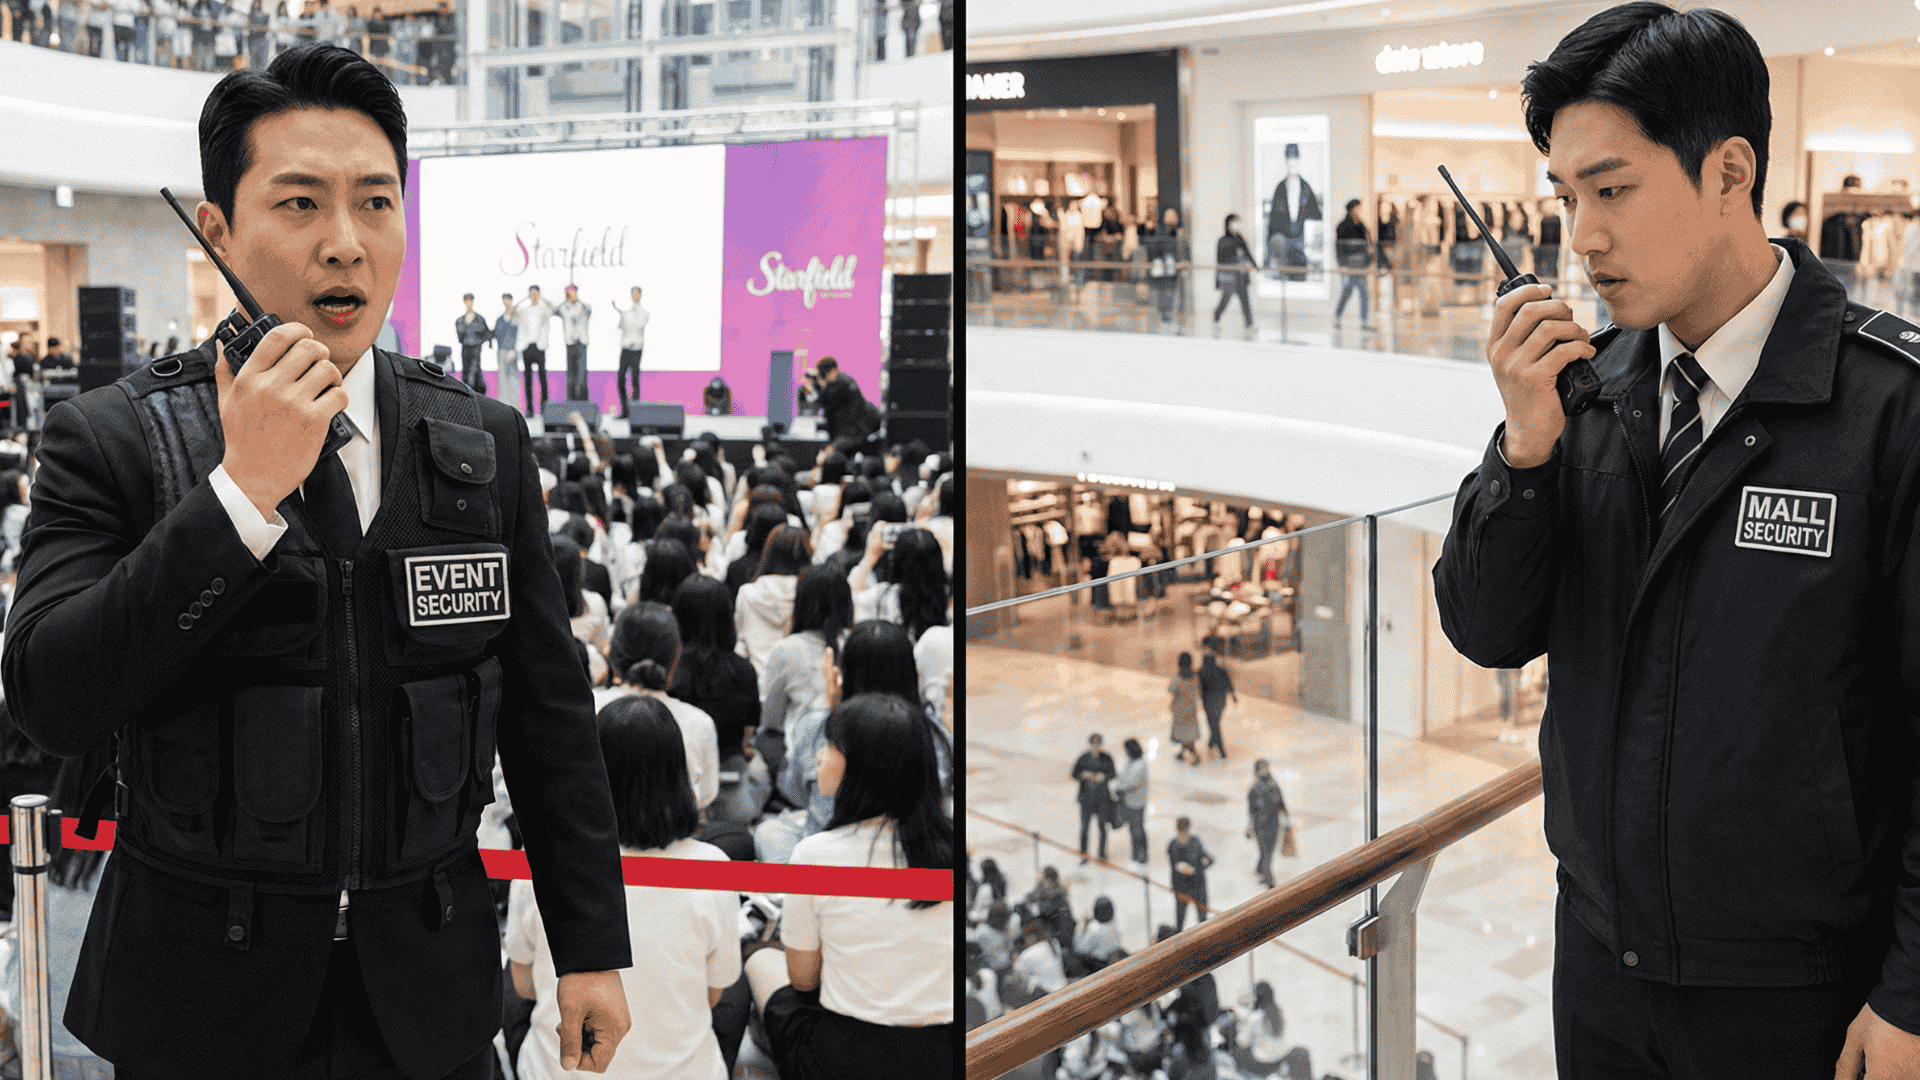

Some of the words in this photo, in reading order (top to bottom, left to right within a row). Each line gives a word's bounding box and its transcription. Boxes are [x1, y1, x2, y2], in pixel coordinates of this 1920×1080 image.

[499, 220, 630, 284] Starfield
[746, 250, 857, 309] Starfield
[1748, 494, 1825, 526] MALL
[1743, 520, 1825, 548] SECURITY
[414, 562, 499, 591] EVENT
[416, 590, 502, 616] SECURITY
